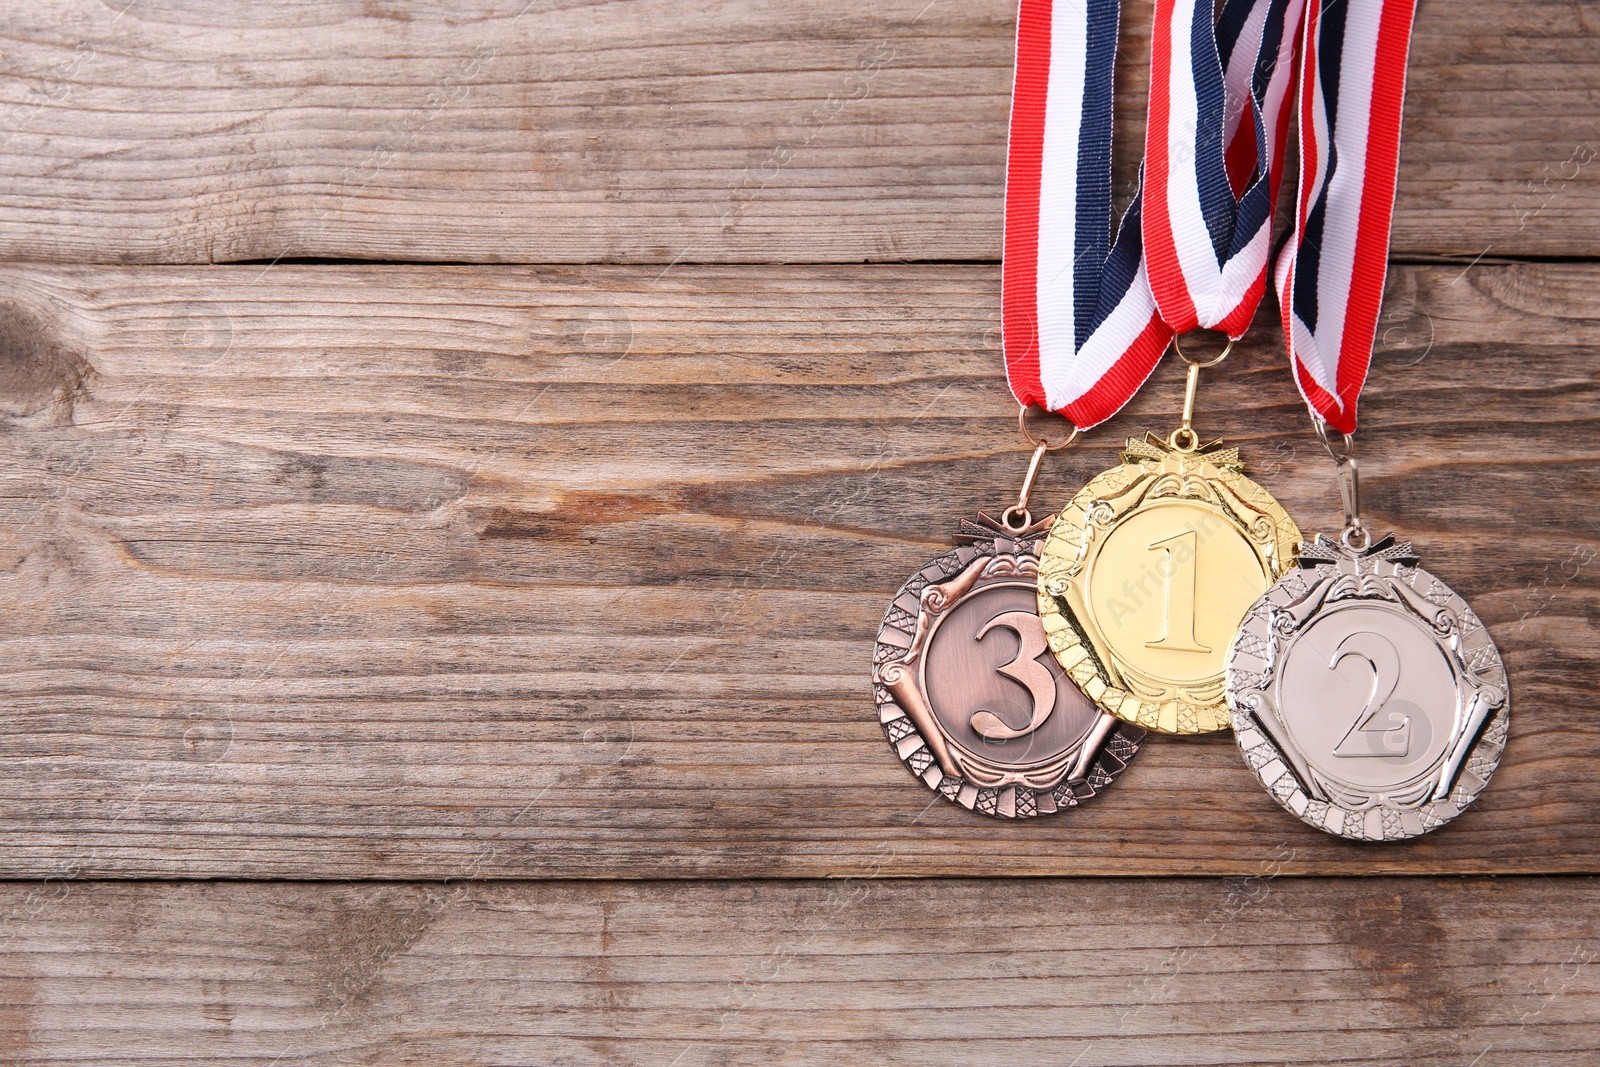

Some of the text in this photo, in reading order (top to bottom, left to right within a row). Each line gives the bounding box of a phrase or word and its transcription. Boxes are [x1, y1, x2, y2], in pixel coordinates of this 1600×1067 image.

[1145, 530, 1212, 653] 1
[970, 610, 1057, 738] 3
[1329, 631, 1411, 757] 2
